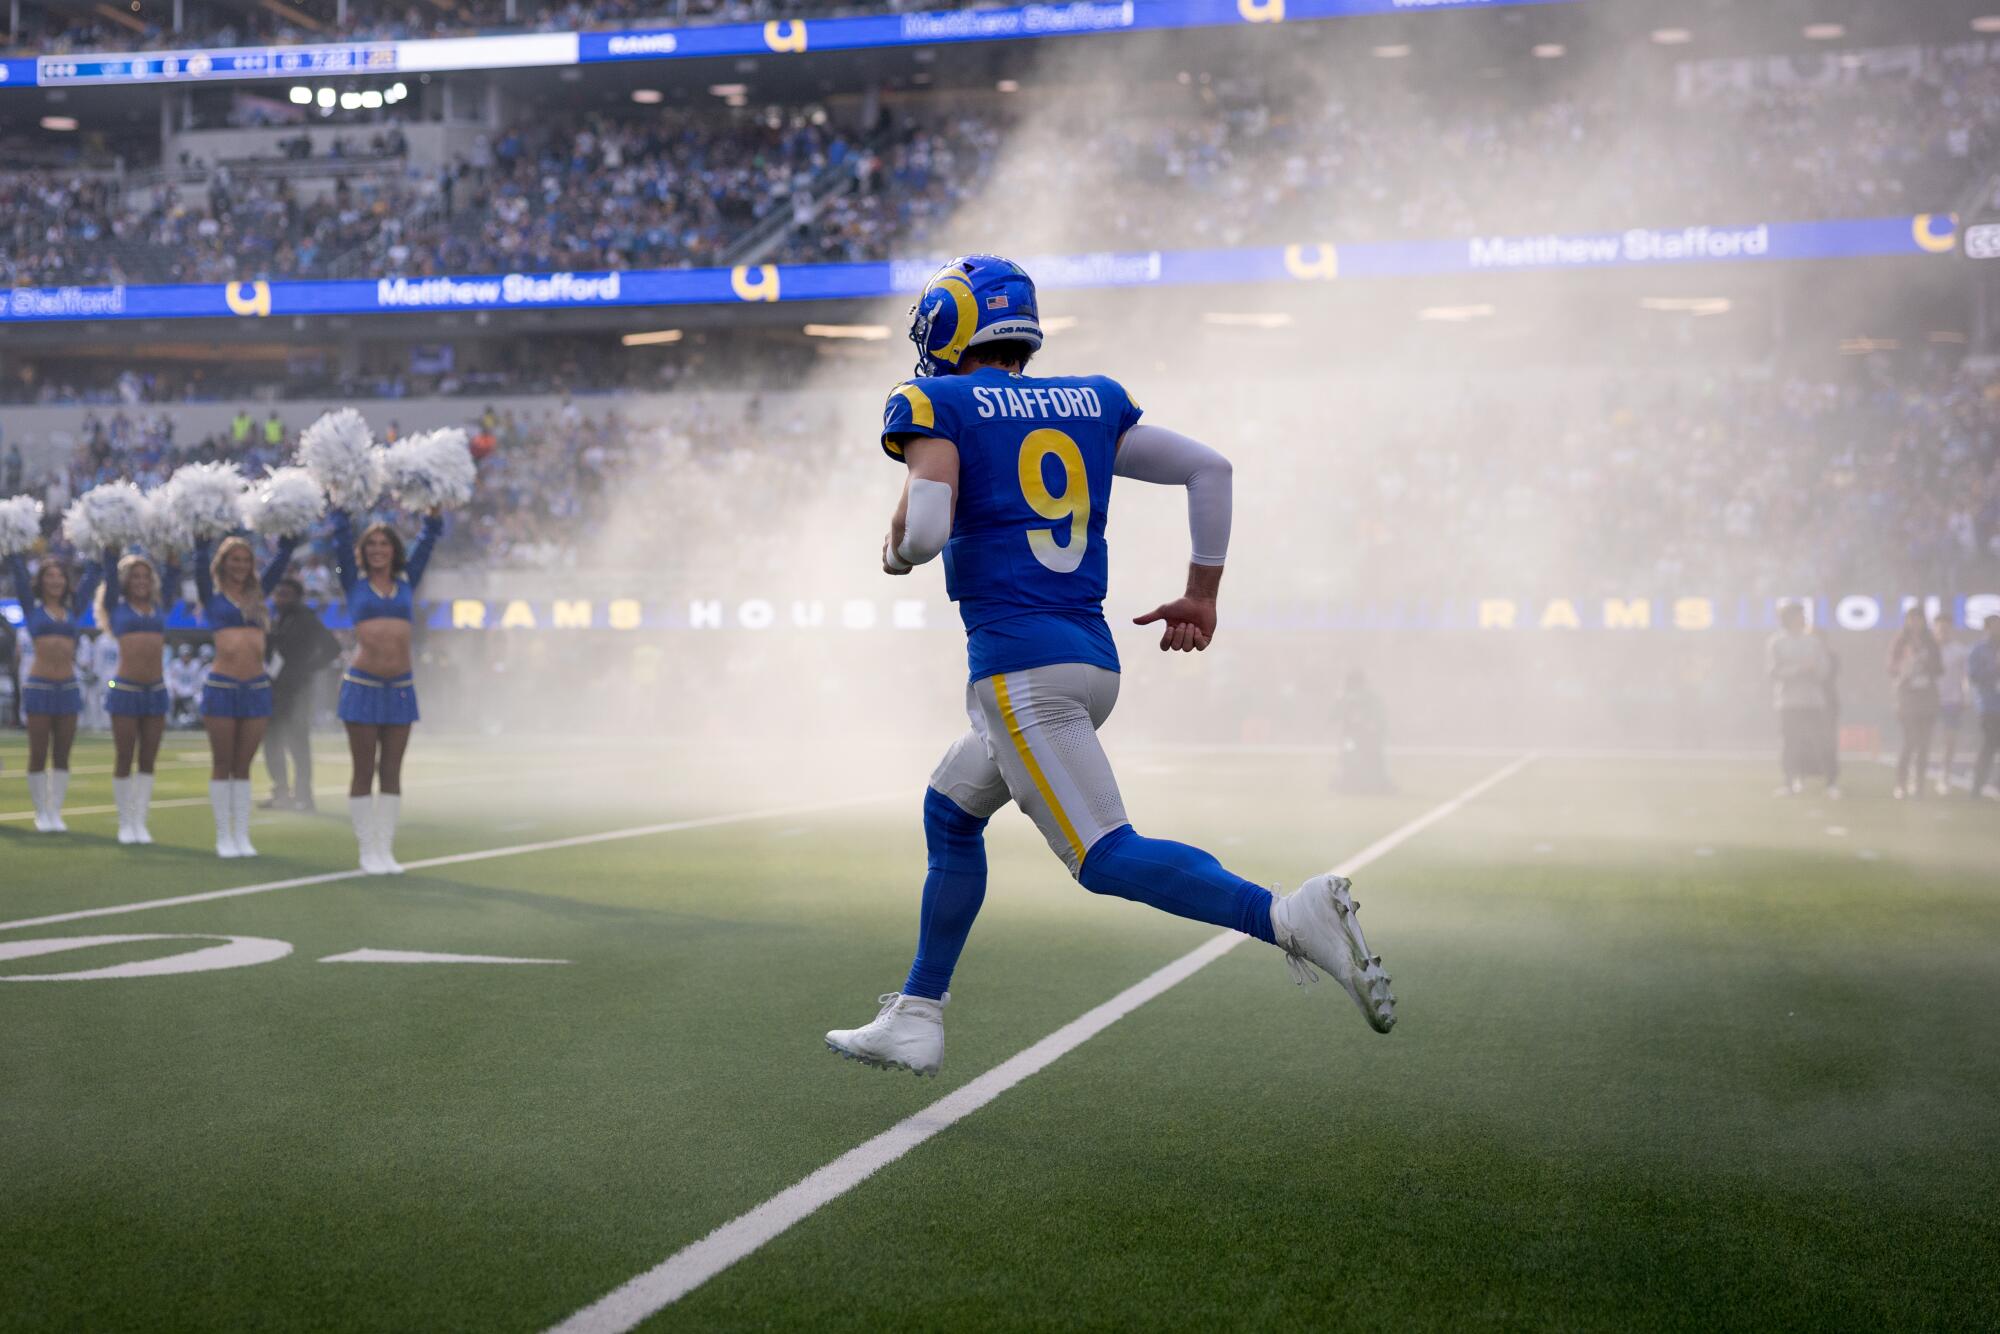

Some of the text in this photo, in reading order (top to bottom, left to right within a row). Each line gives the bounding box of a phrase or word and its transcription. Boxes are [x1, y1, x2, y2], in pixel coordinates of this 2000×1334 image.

[1469, 222, 1768, 267] Matthew Stafford
[378, 271, 620, 306] Matthew Stafford
[993, 326, 1014, 336] LOS
[972, 386, 1102, 419] STAFFORD
[1018, 428, 1091, 574] 9
[451, 600, 927, 630] RAMS HOUSE
[1476, 598, 1713, 630] RAMS
